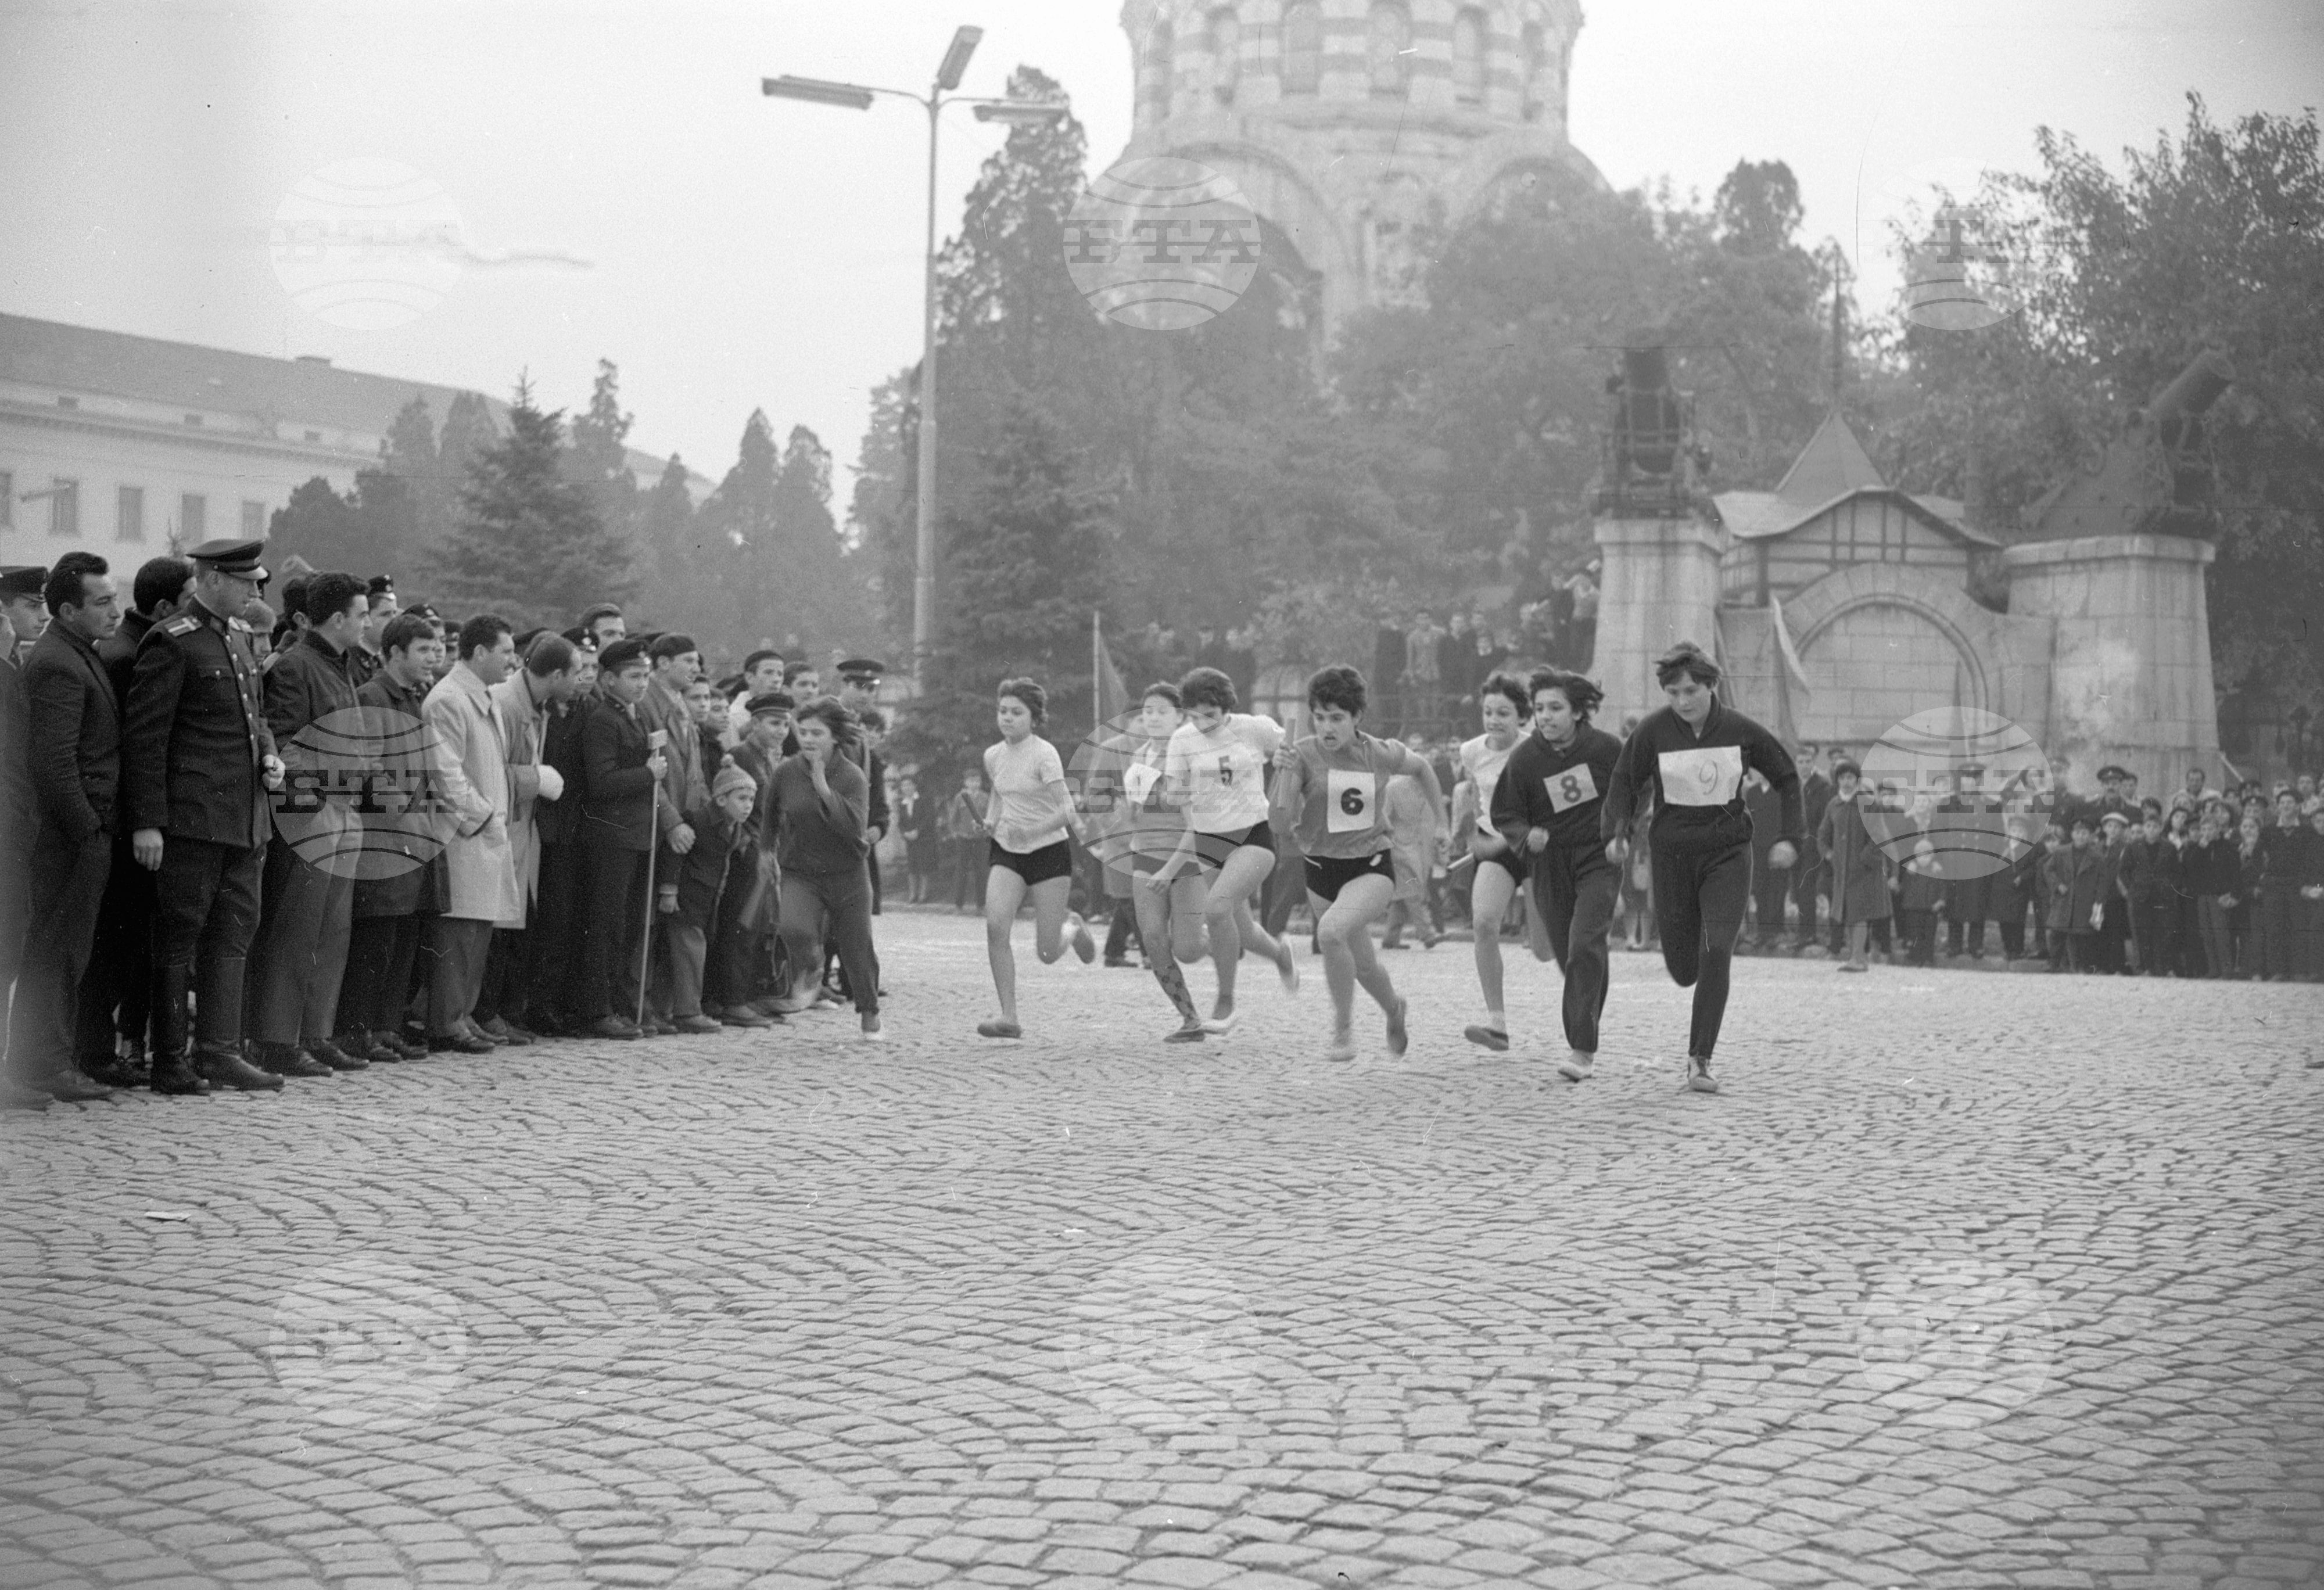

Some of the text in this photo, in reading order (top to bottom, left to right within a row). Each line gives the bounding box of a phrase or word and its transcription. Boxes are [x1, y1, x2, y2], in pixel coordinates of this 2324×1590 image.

[1218, 755, 1233, 786] 5
[1699, 760, 1719, 796] 9
[1341, 787, 1364, 816] 6
[1561, 775, 1581, 803] 8
